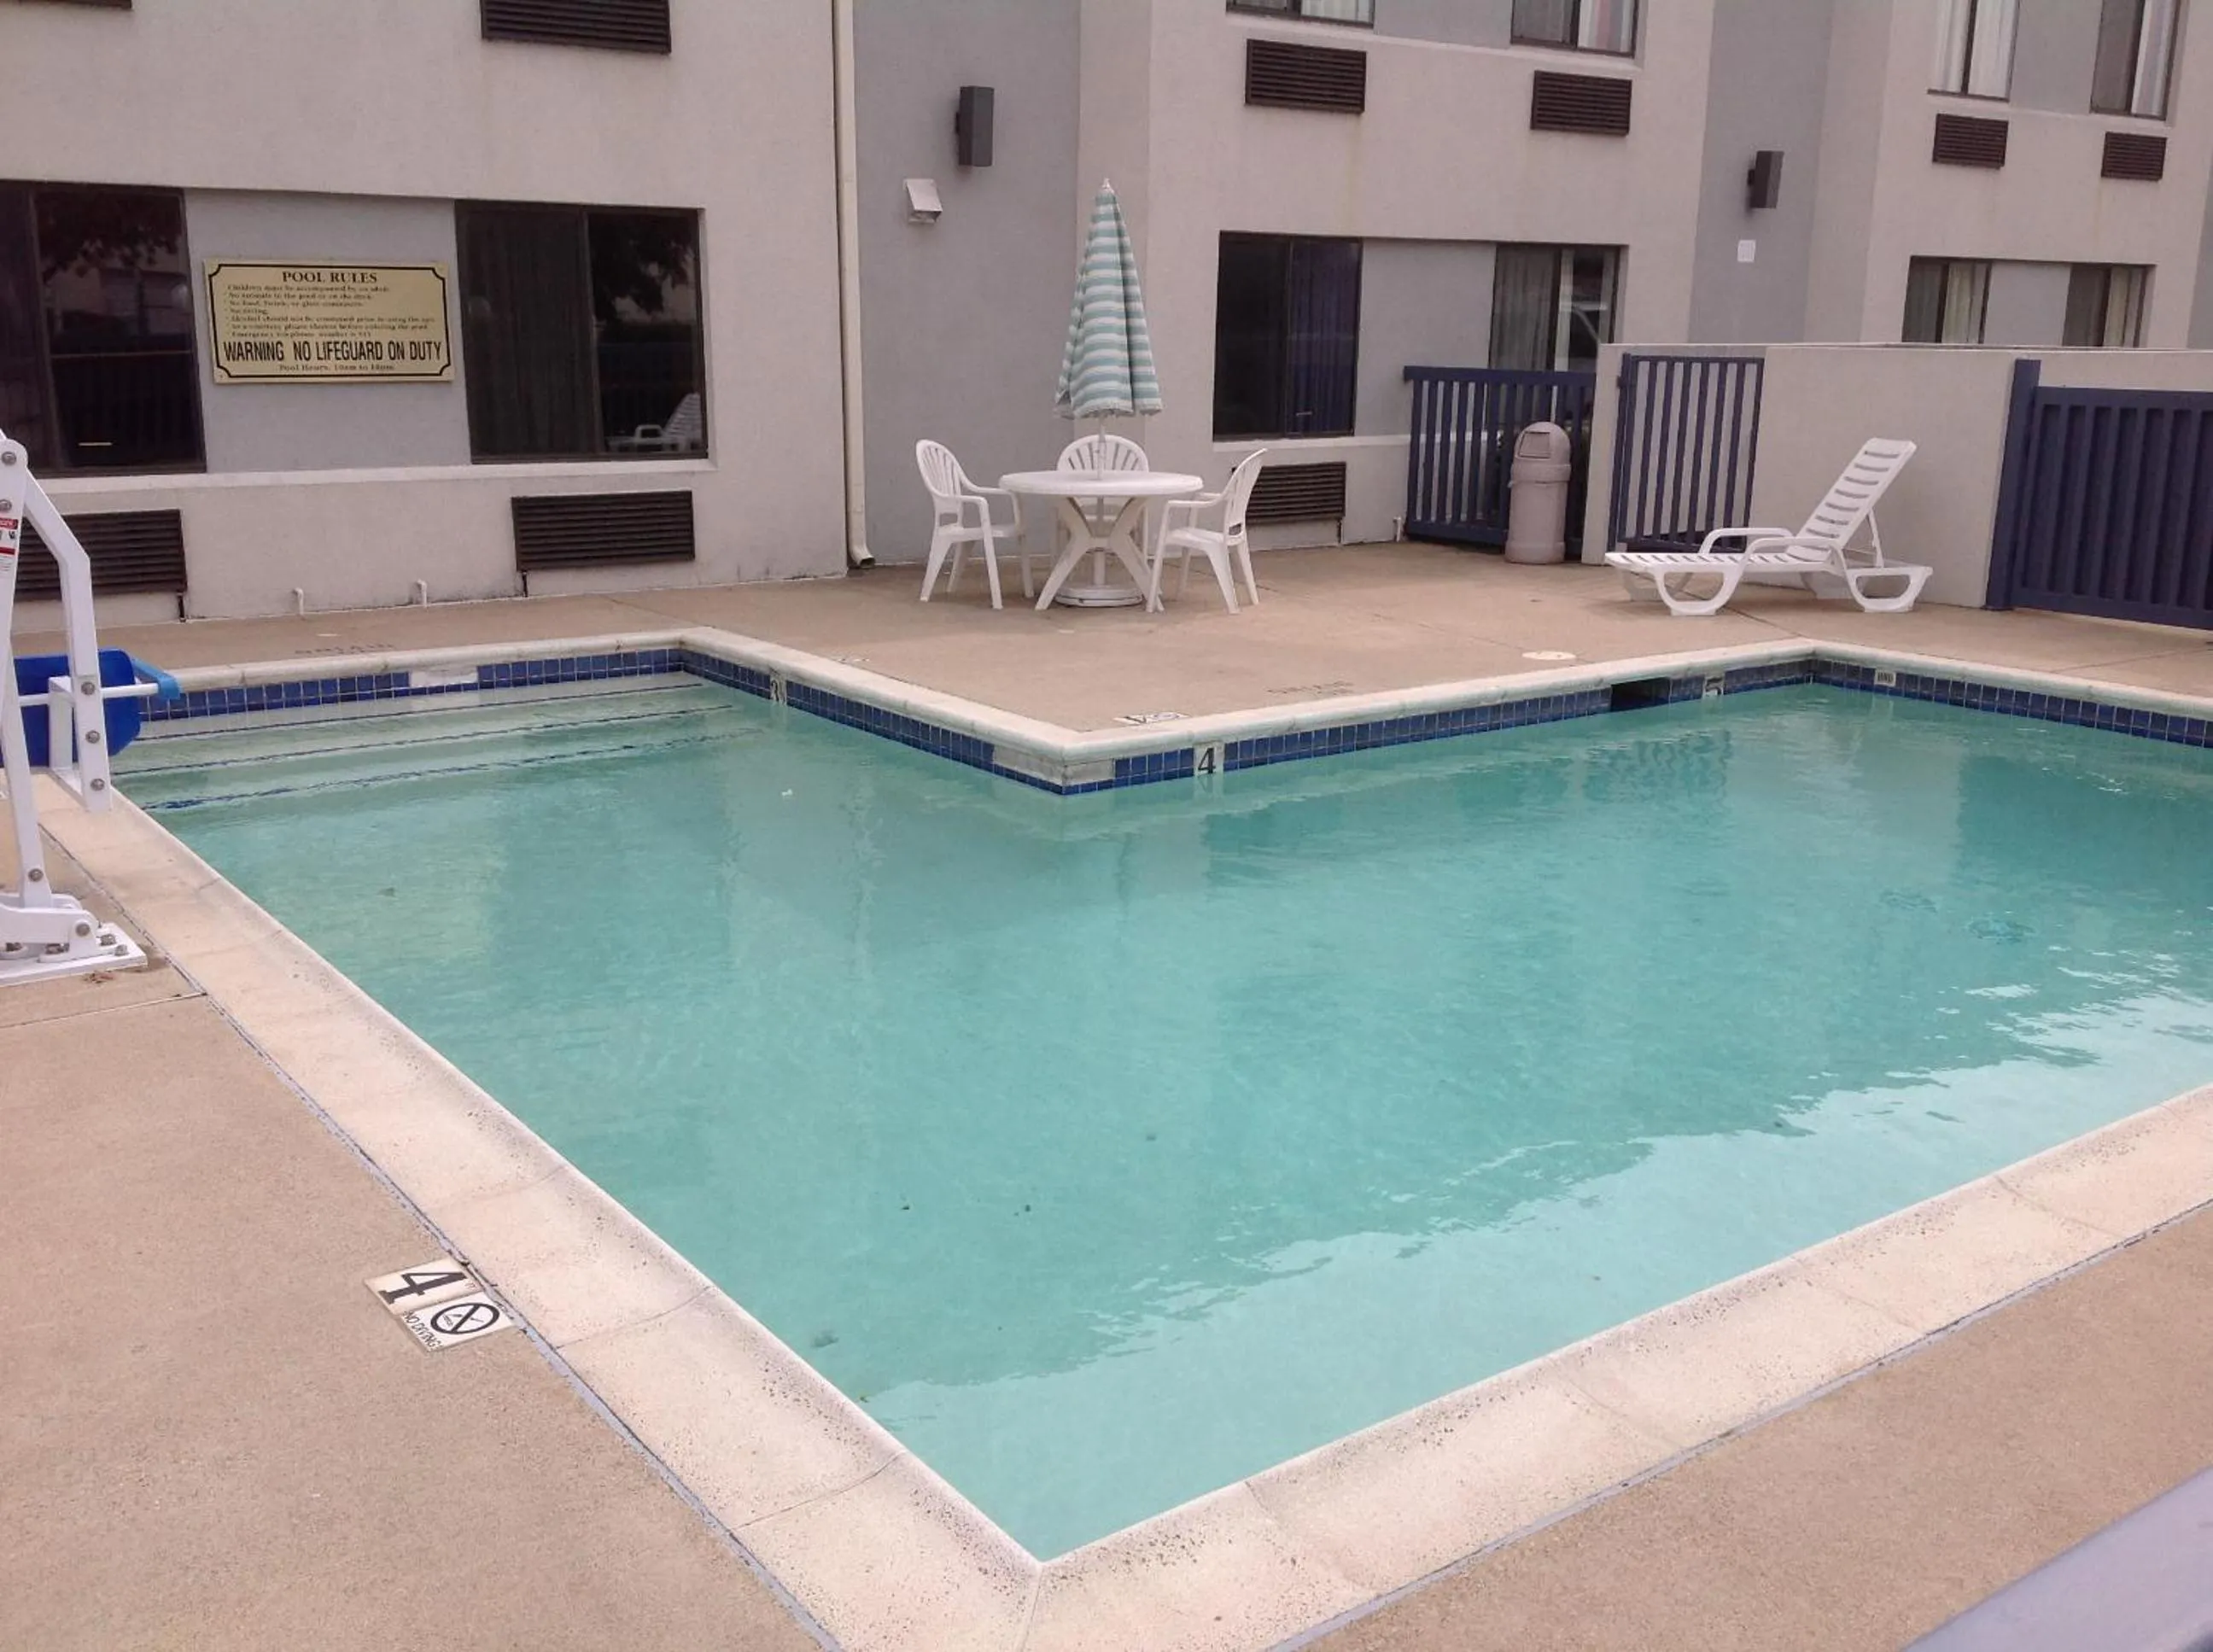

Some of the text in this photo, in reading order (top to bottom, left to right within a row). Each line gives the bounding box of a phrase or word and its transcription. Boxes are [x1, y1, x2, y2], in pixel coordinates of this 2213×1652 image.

[282, 271, 378, 283] POOL RULES
[223, 340, 441, 361] WARNING NO LIFEGUARD ON DUTY
[1197, 747, 1216, 773] 4
[378, 1271, 468, 1305] 4
[402, 1310, 417, 1323] NO
